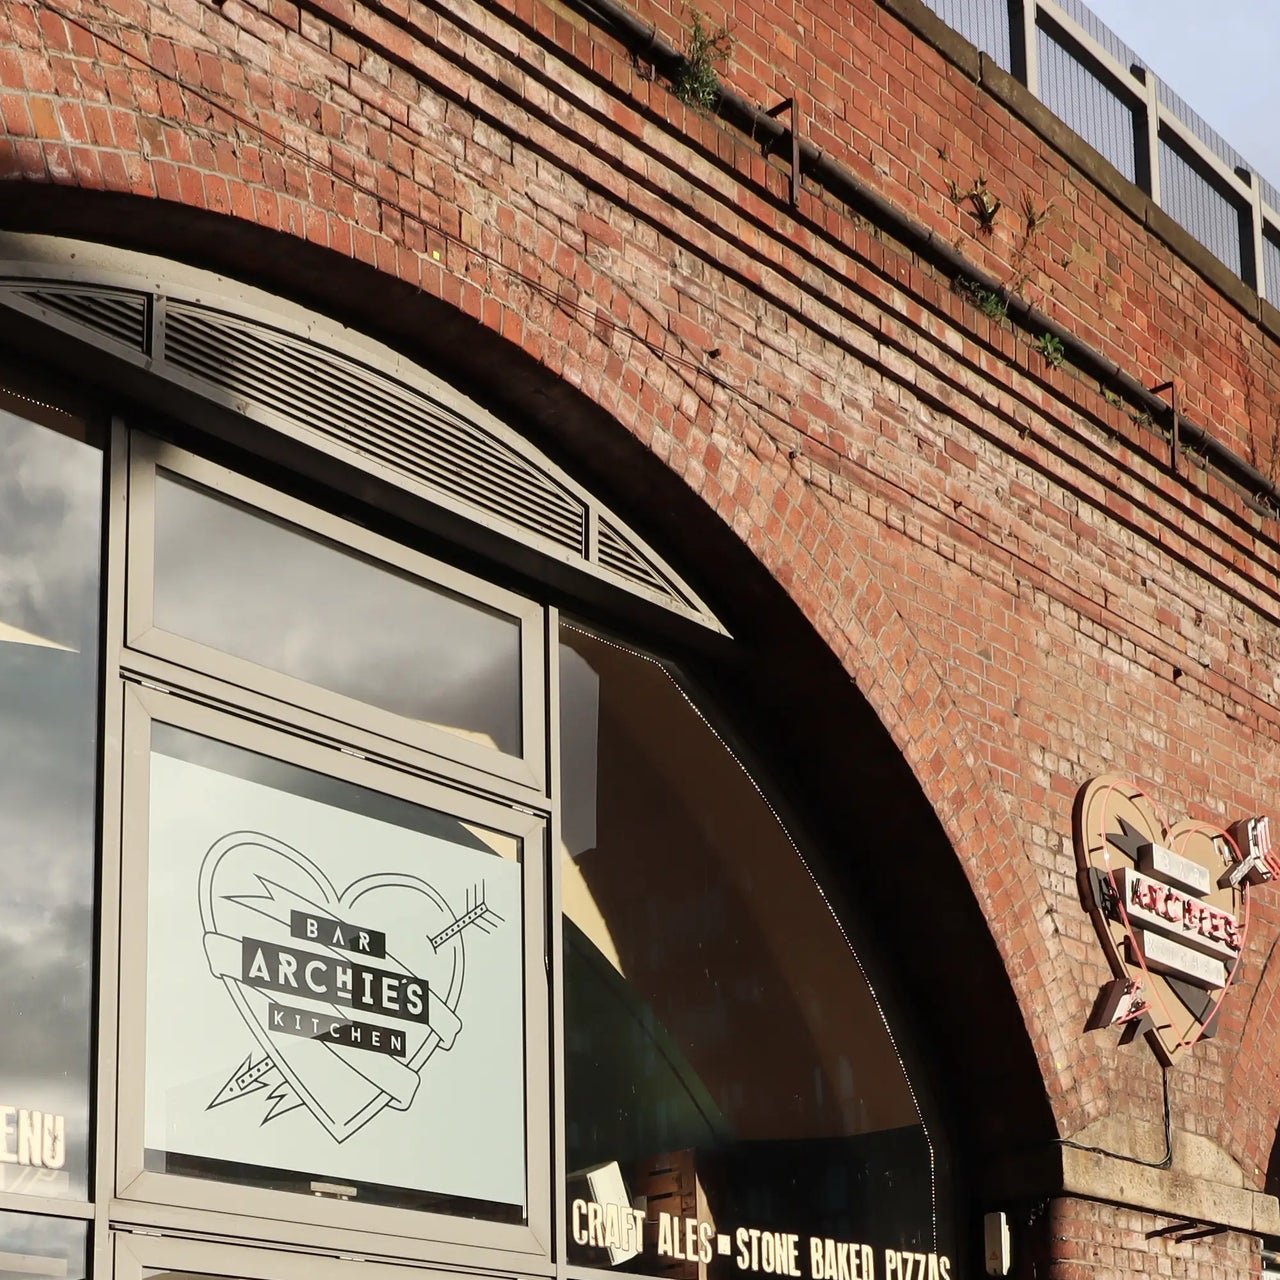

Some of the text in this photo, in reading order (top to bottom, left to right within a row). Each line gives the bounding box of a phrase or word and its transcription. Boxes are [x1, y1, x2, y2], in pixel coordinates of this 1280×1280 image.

[306, 918, 370, 952] BAR
[274, 1010, 402, 1051] KITCHEN
[571, 1198, 646, 1254] CRAFT
[658, 1212, 714, 1265] ALES
[736, 1227, 802, 1279] STONE
